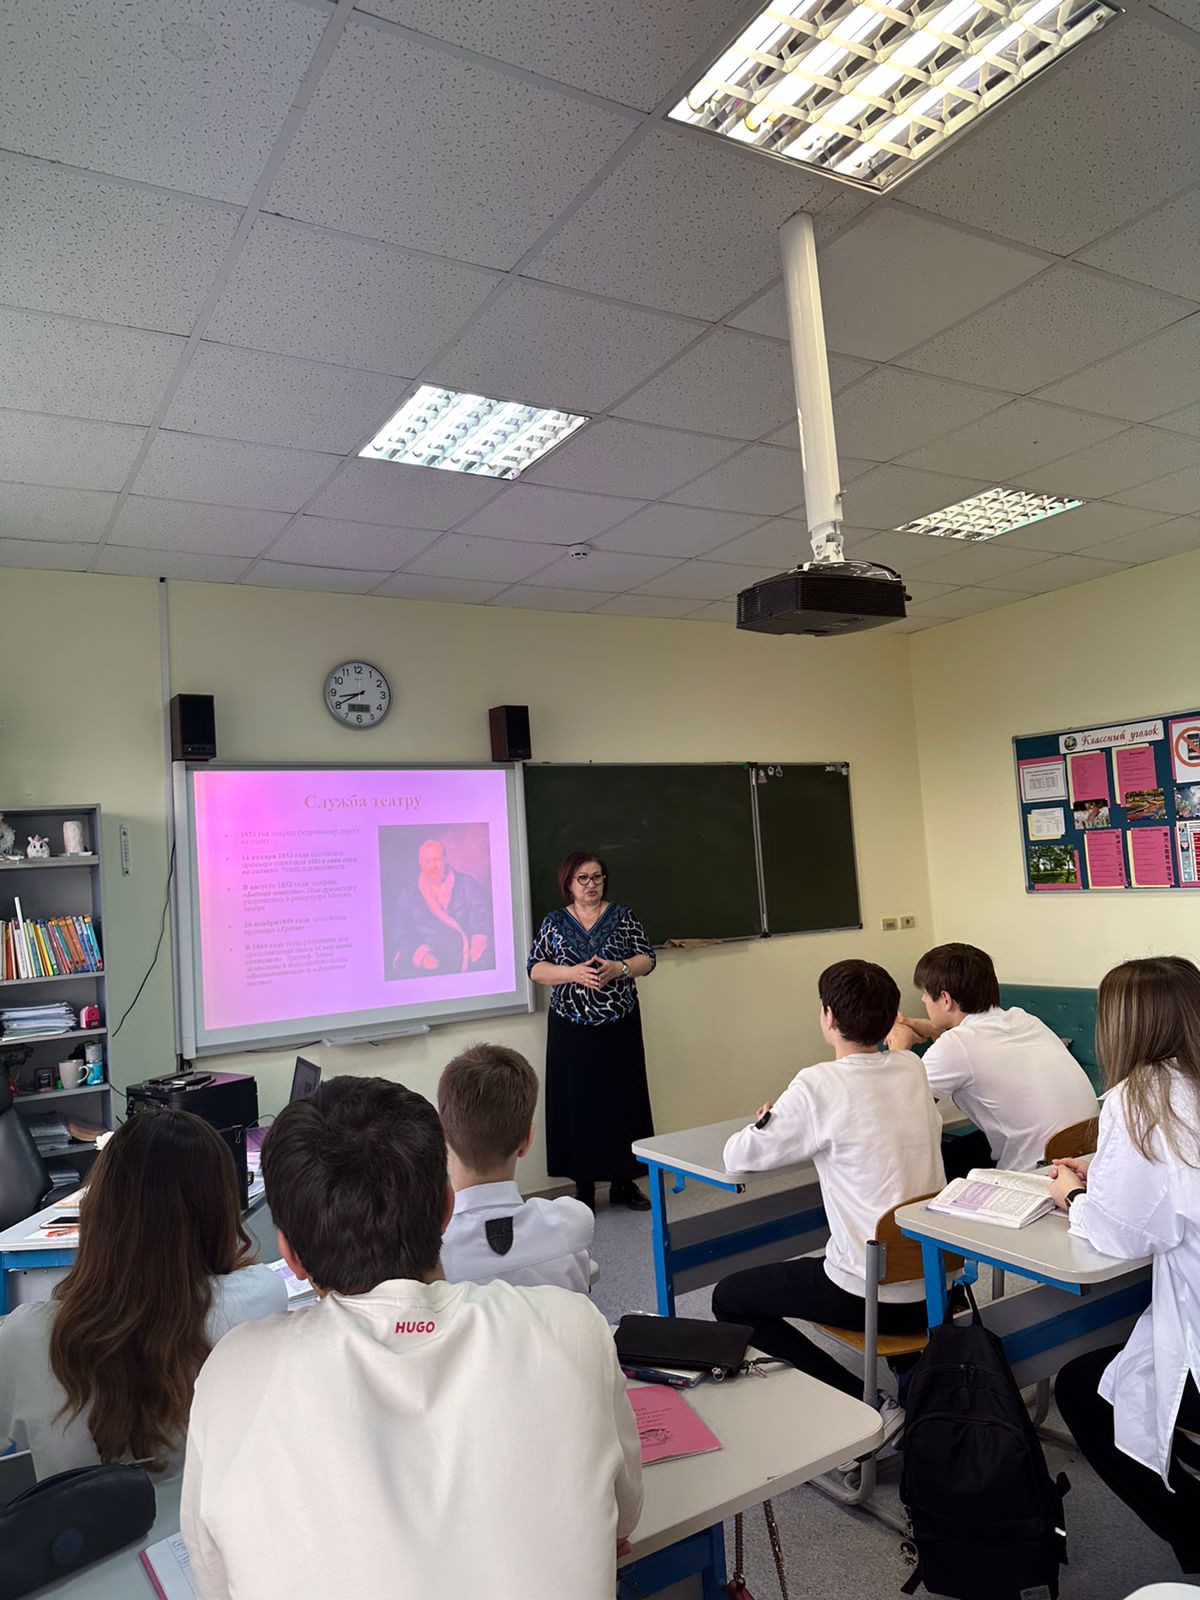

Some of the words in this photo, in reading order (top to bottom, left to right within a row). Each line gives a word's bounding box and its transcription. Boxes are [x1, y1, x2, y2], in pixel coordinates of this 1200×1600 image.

[342, 668, 349, 676] 11
[353, 666, 362, 674] 12
[334, 676, 343, 685] 10
[376, 680, 382, 688] 2
[331, 688, 336, 696] 9
[380, 691, 385, 700] 3
[356, 714, 362, 723] 6
[1081, 730, 1125, 746] Классный
[1129, 724, 1159, 741] уголок
[304, 794, 367, 812] Служба
[372, 795, 422, 810] театру
[395, 1321, 435, 1333] HUGO
